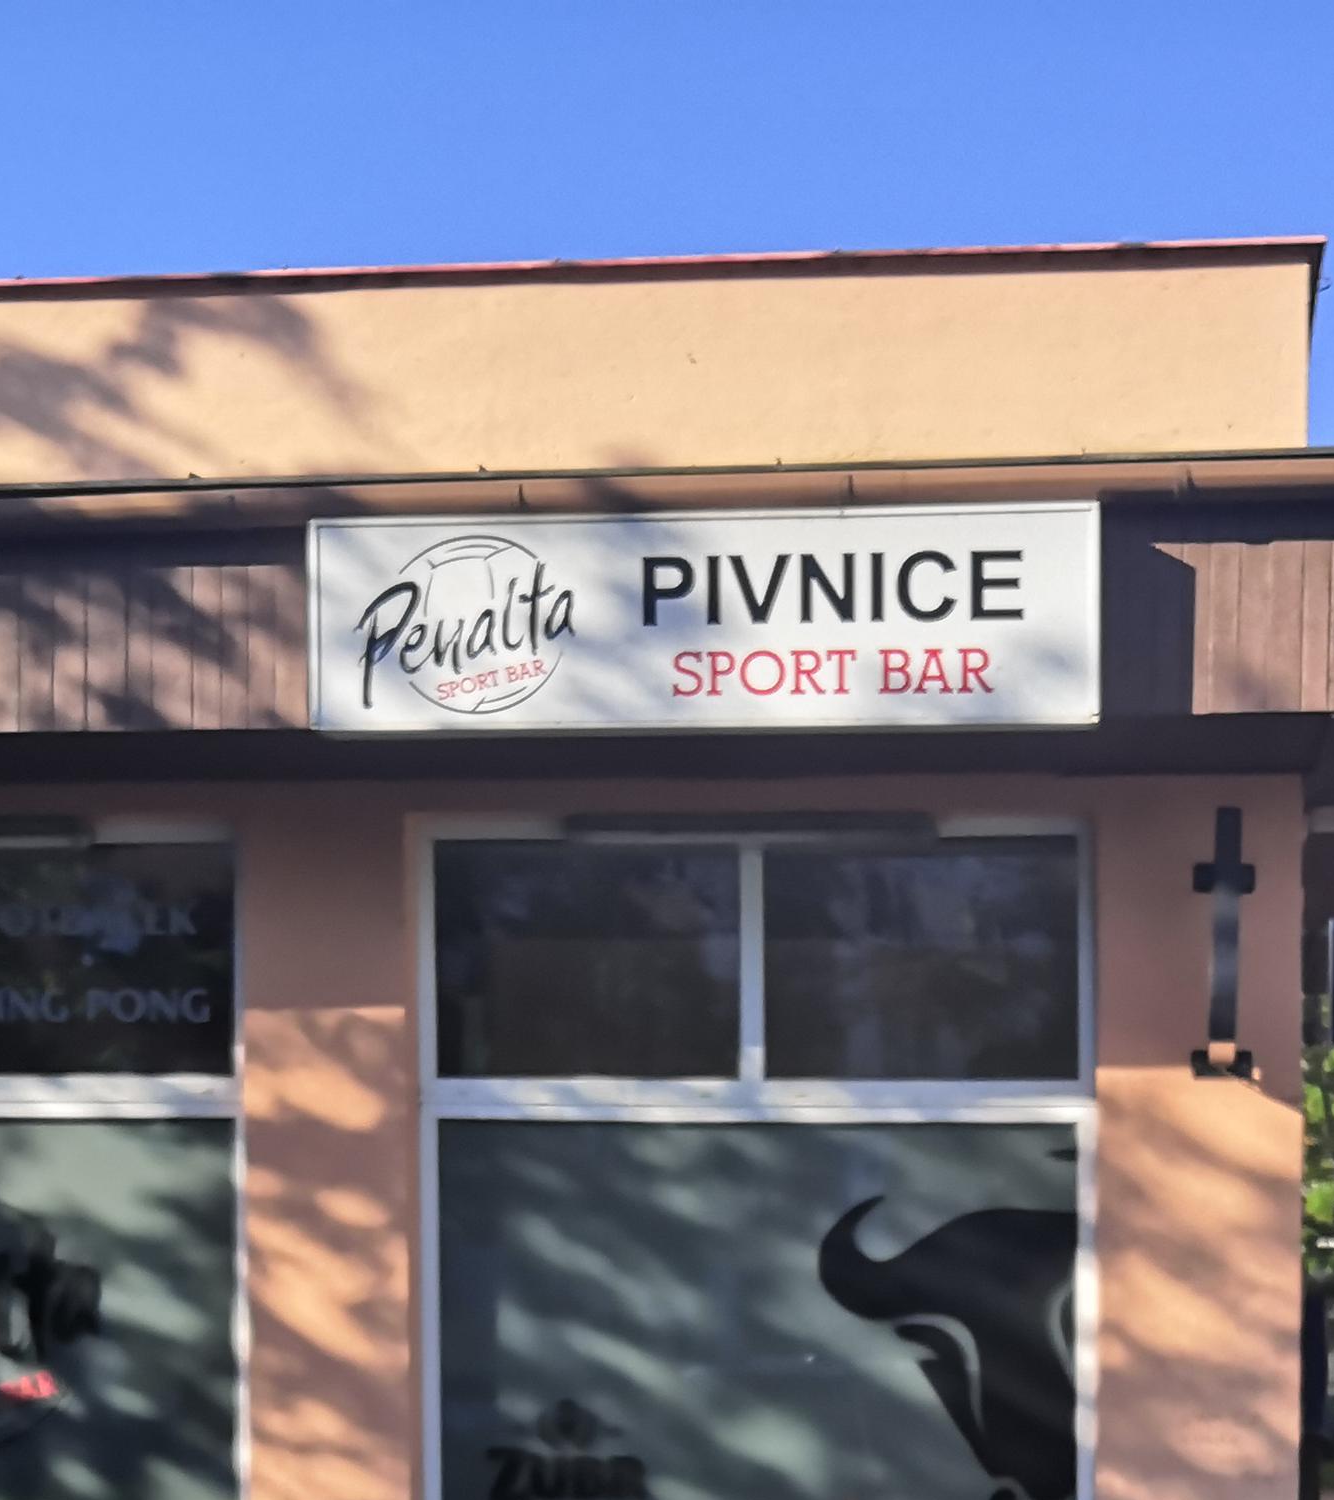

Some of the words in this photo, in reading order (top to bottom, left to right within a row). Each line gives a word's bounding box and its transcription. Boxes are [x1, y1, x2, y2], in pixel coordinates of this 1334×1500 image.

[641, 548, 1025, 627] PIVNICE
[354, 560, 576, 710] Penalta
[436, 670, 500, 701] SPORT
[504, 659, 548, 684] BAR
[671, 649, 859, 699] SPORT
[878, 647, 995, 695] BAR
[86, 987, 211, 1023] PONG
